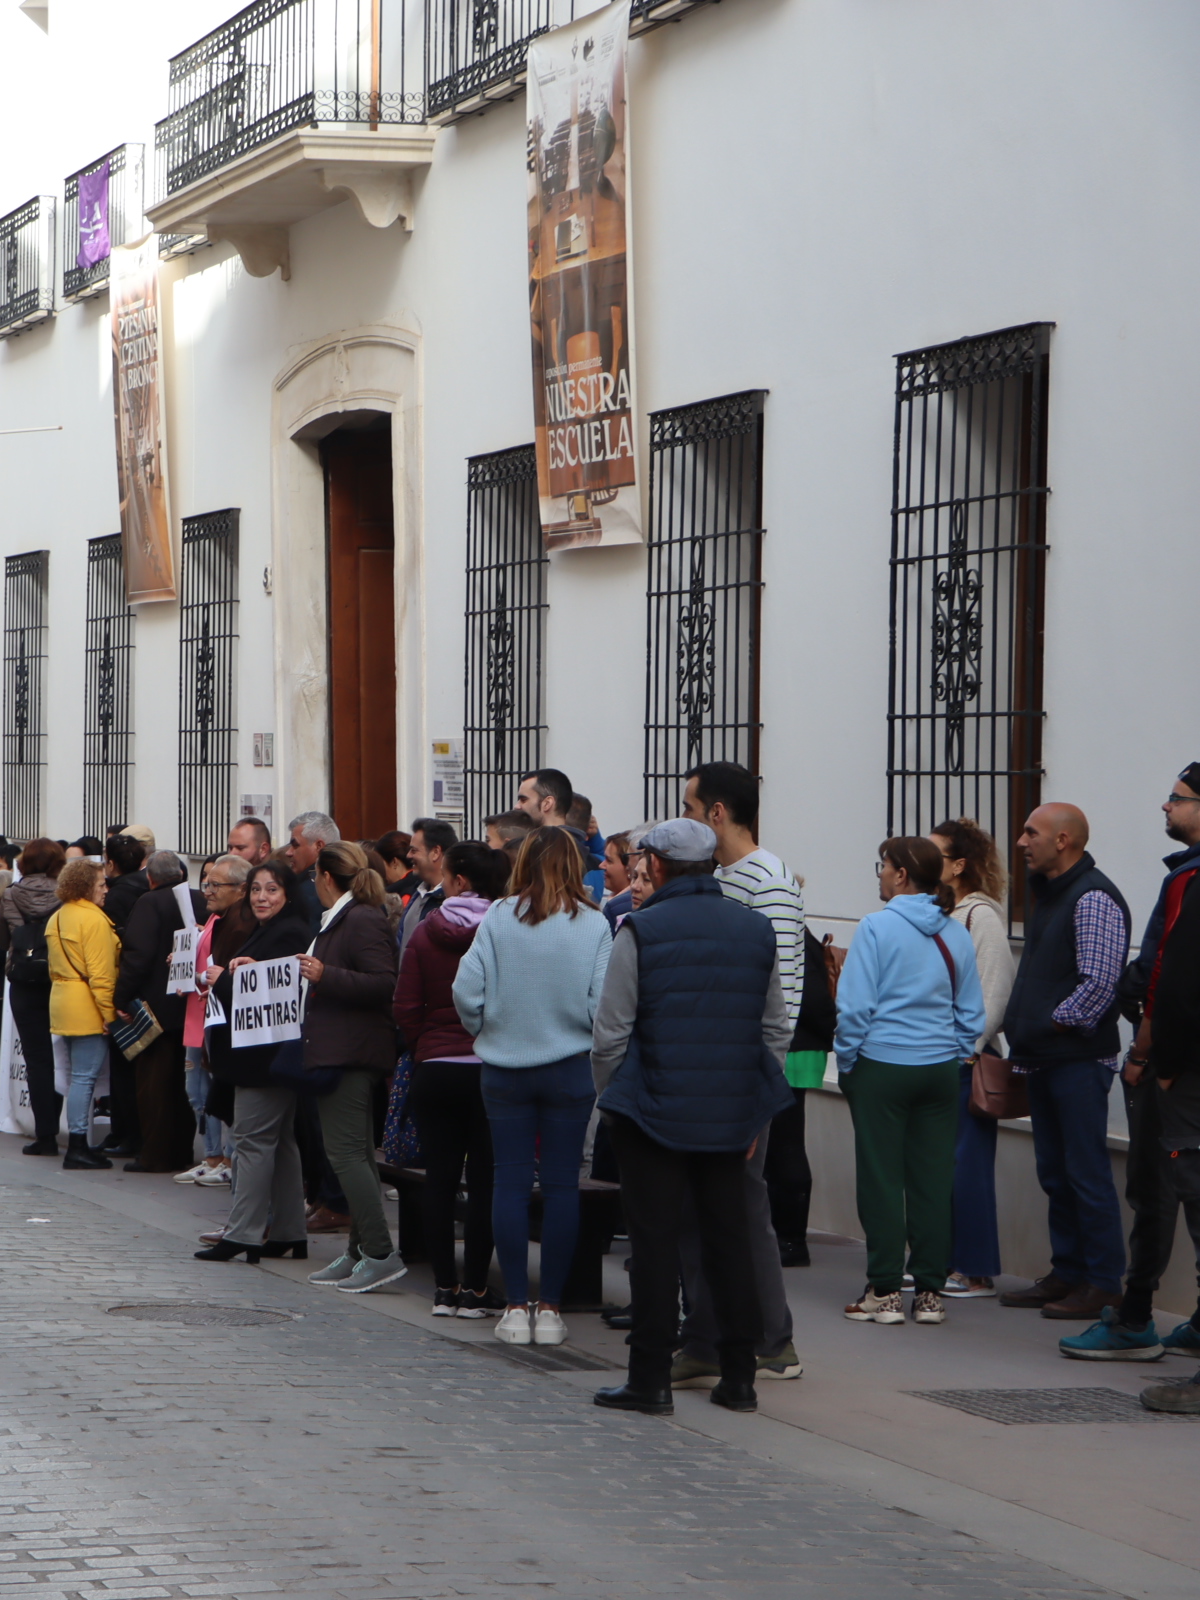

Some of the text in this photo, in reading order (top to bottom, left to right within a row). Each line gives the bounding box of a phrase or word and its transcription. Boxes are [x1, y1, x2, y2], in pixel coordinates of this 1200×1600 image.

[568, 356, 603, 376] permanente
[546, 371, 632, 423] NUESTRA
[548, 416, 634, 470] ESCUELA
[170, 961, 194, 982] ENTIRAS
[240, 963, 292, 994] NO MAS
[234, 999, 298, 1031] MENTIRAS
